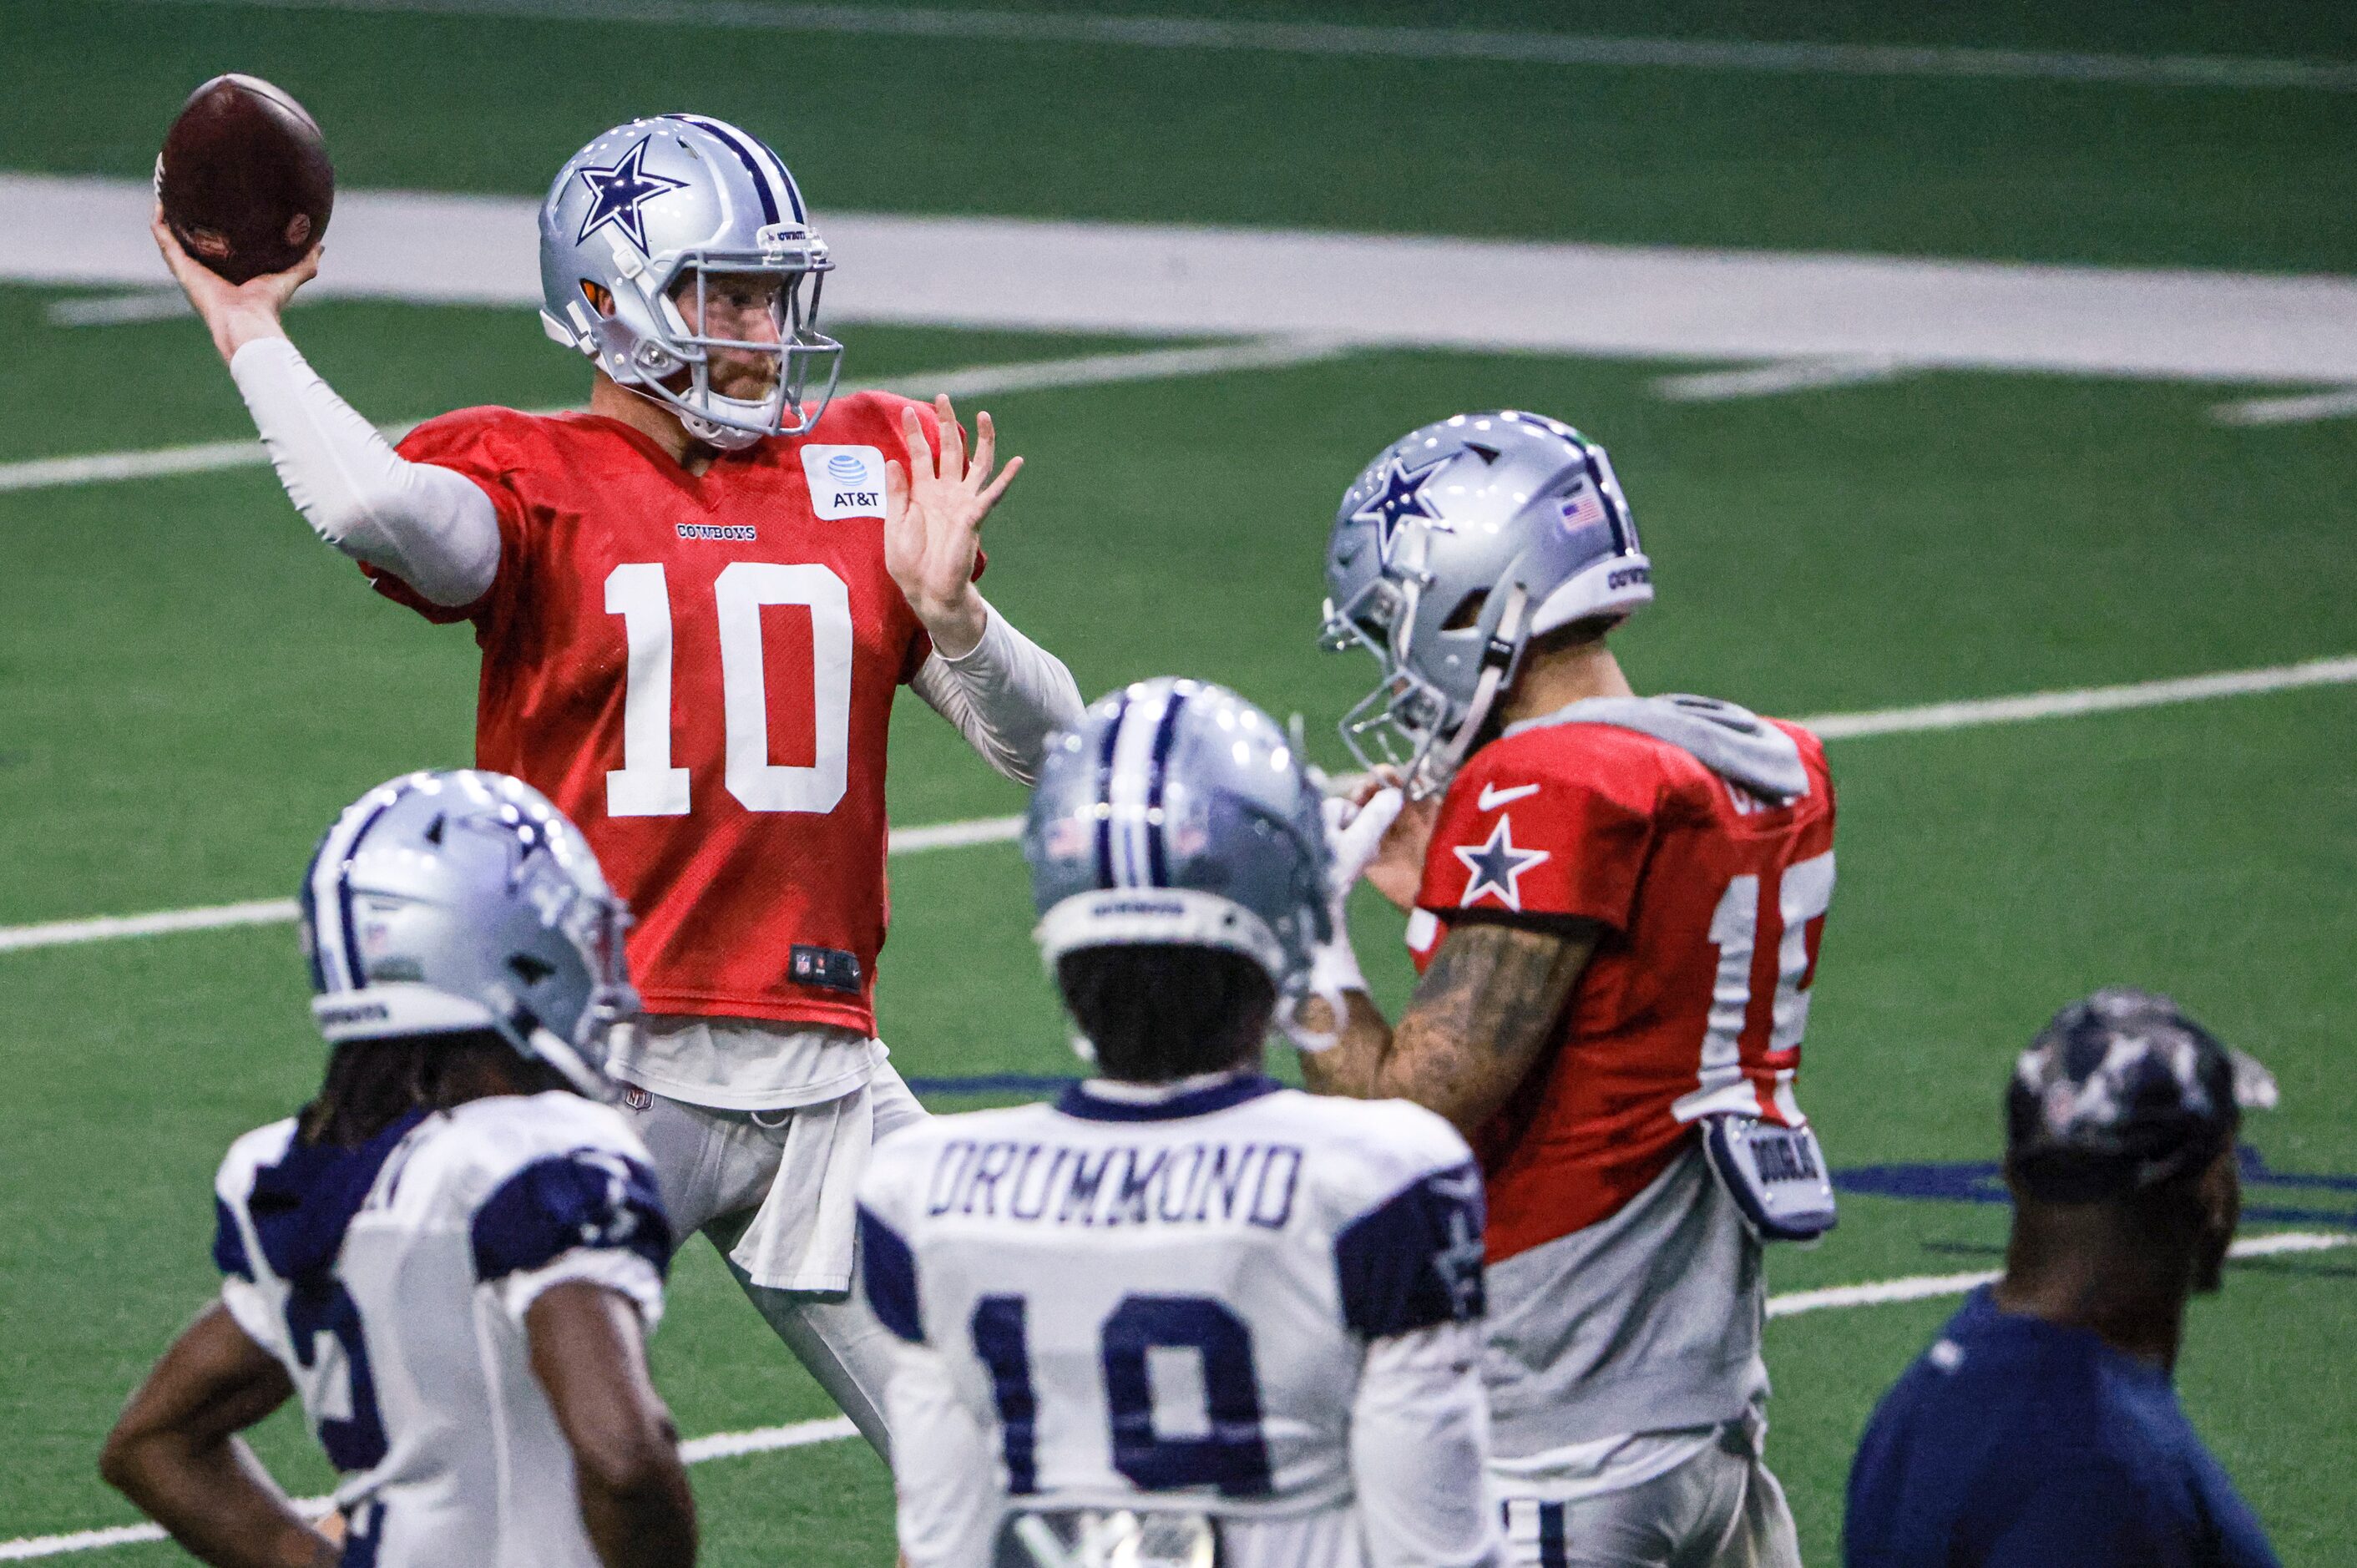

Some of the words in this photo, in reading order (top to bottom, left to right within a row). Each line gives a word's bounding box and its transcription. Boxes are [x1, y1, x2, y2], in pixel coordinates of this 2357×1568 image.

[833, 492, 879, 508] AT&T
[676, 524, 756, 540] COWBOYS
[604, 561, 853, 817] 10
[928, 1141, 1302, 1230] DRUMMOND
